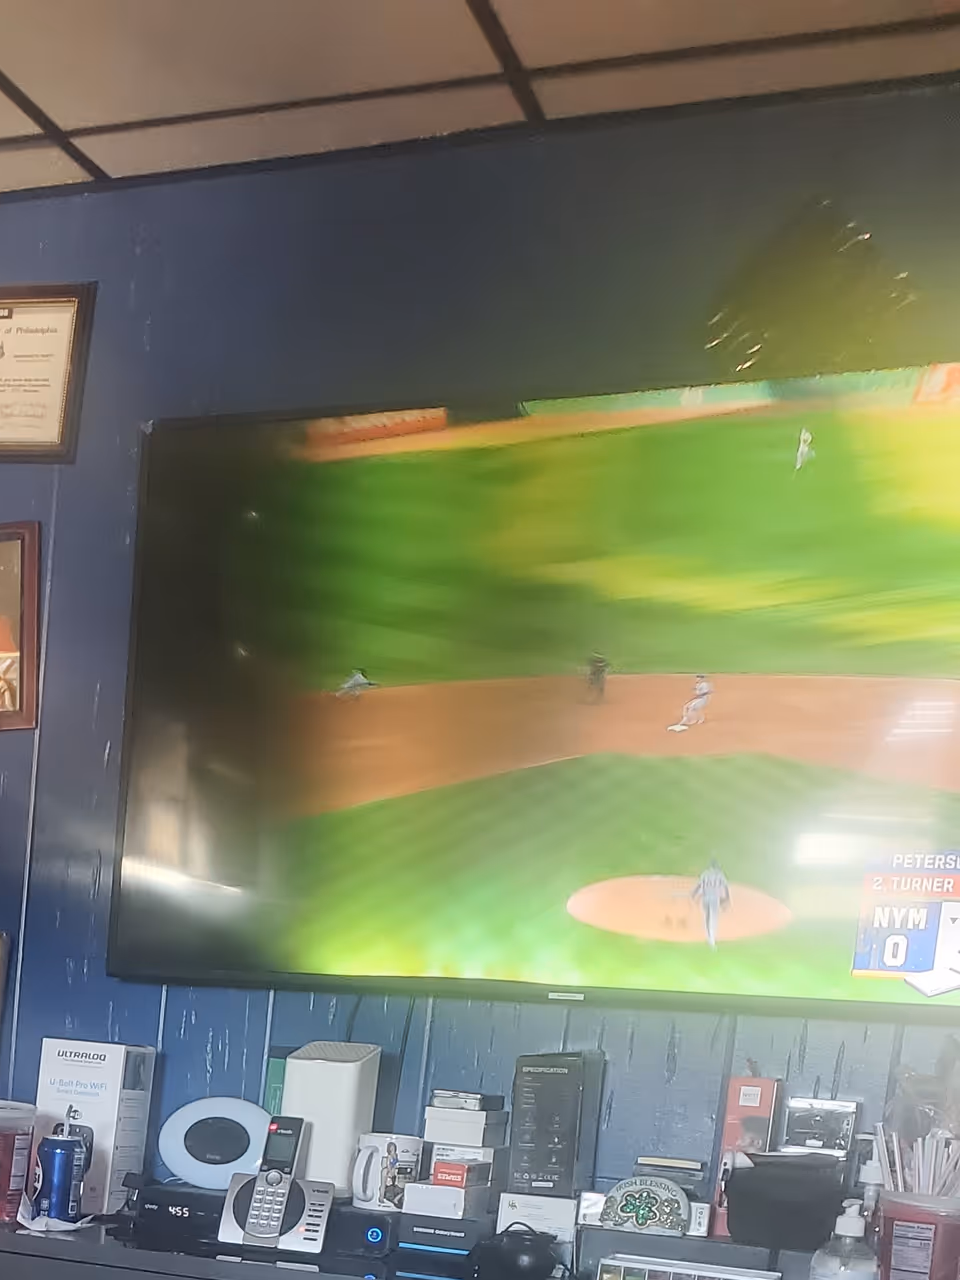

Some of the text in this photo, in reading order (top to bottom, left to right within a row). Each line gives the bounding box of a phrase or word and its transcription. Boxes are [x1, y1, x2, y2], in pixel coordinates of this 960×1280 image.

[892, 876, 954, 892] TURNER
[873, 904, 929, 931] NYM
[882, 934, 909, 968] 0
[56, 1049, 107, 1062] ULTRALOQ
[75, 1079, 89, 1089] Pro
[616, 1179, 679, 1197] IRISH BLESSING
